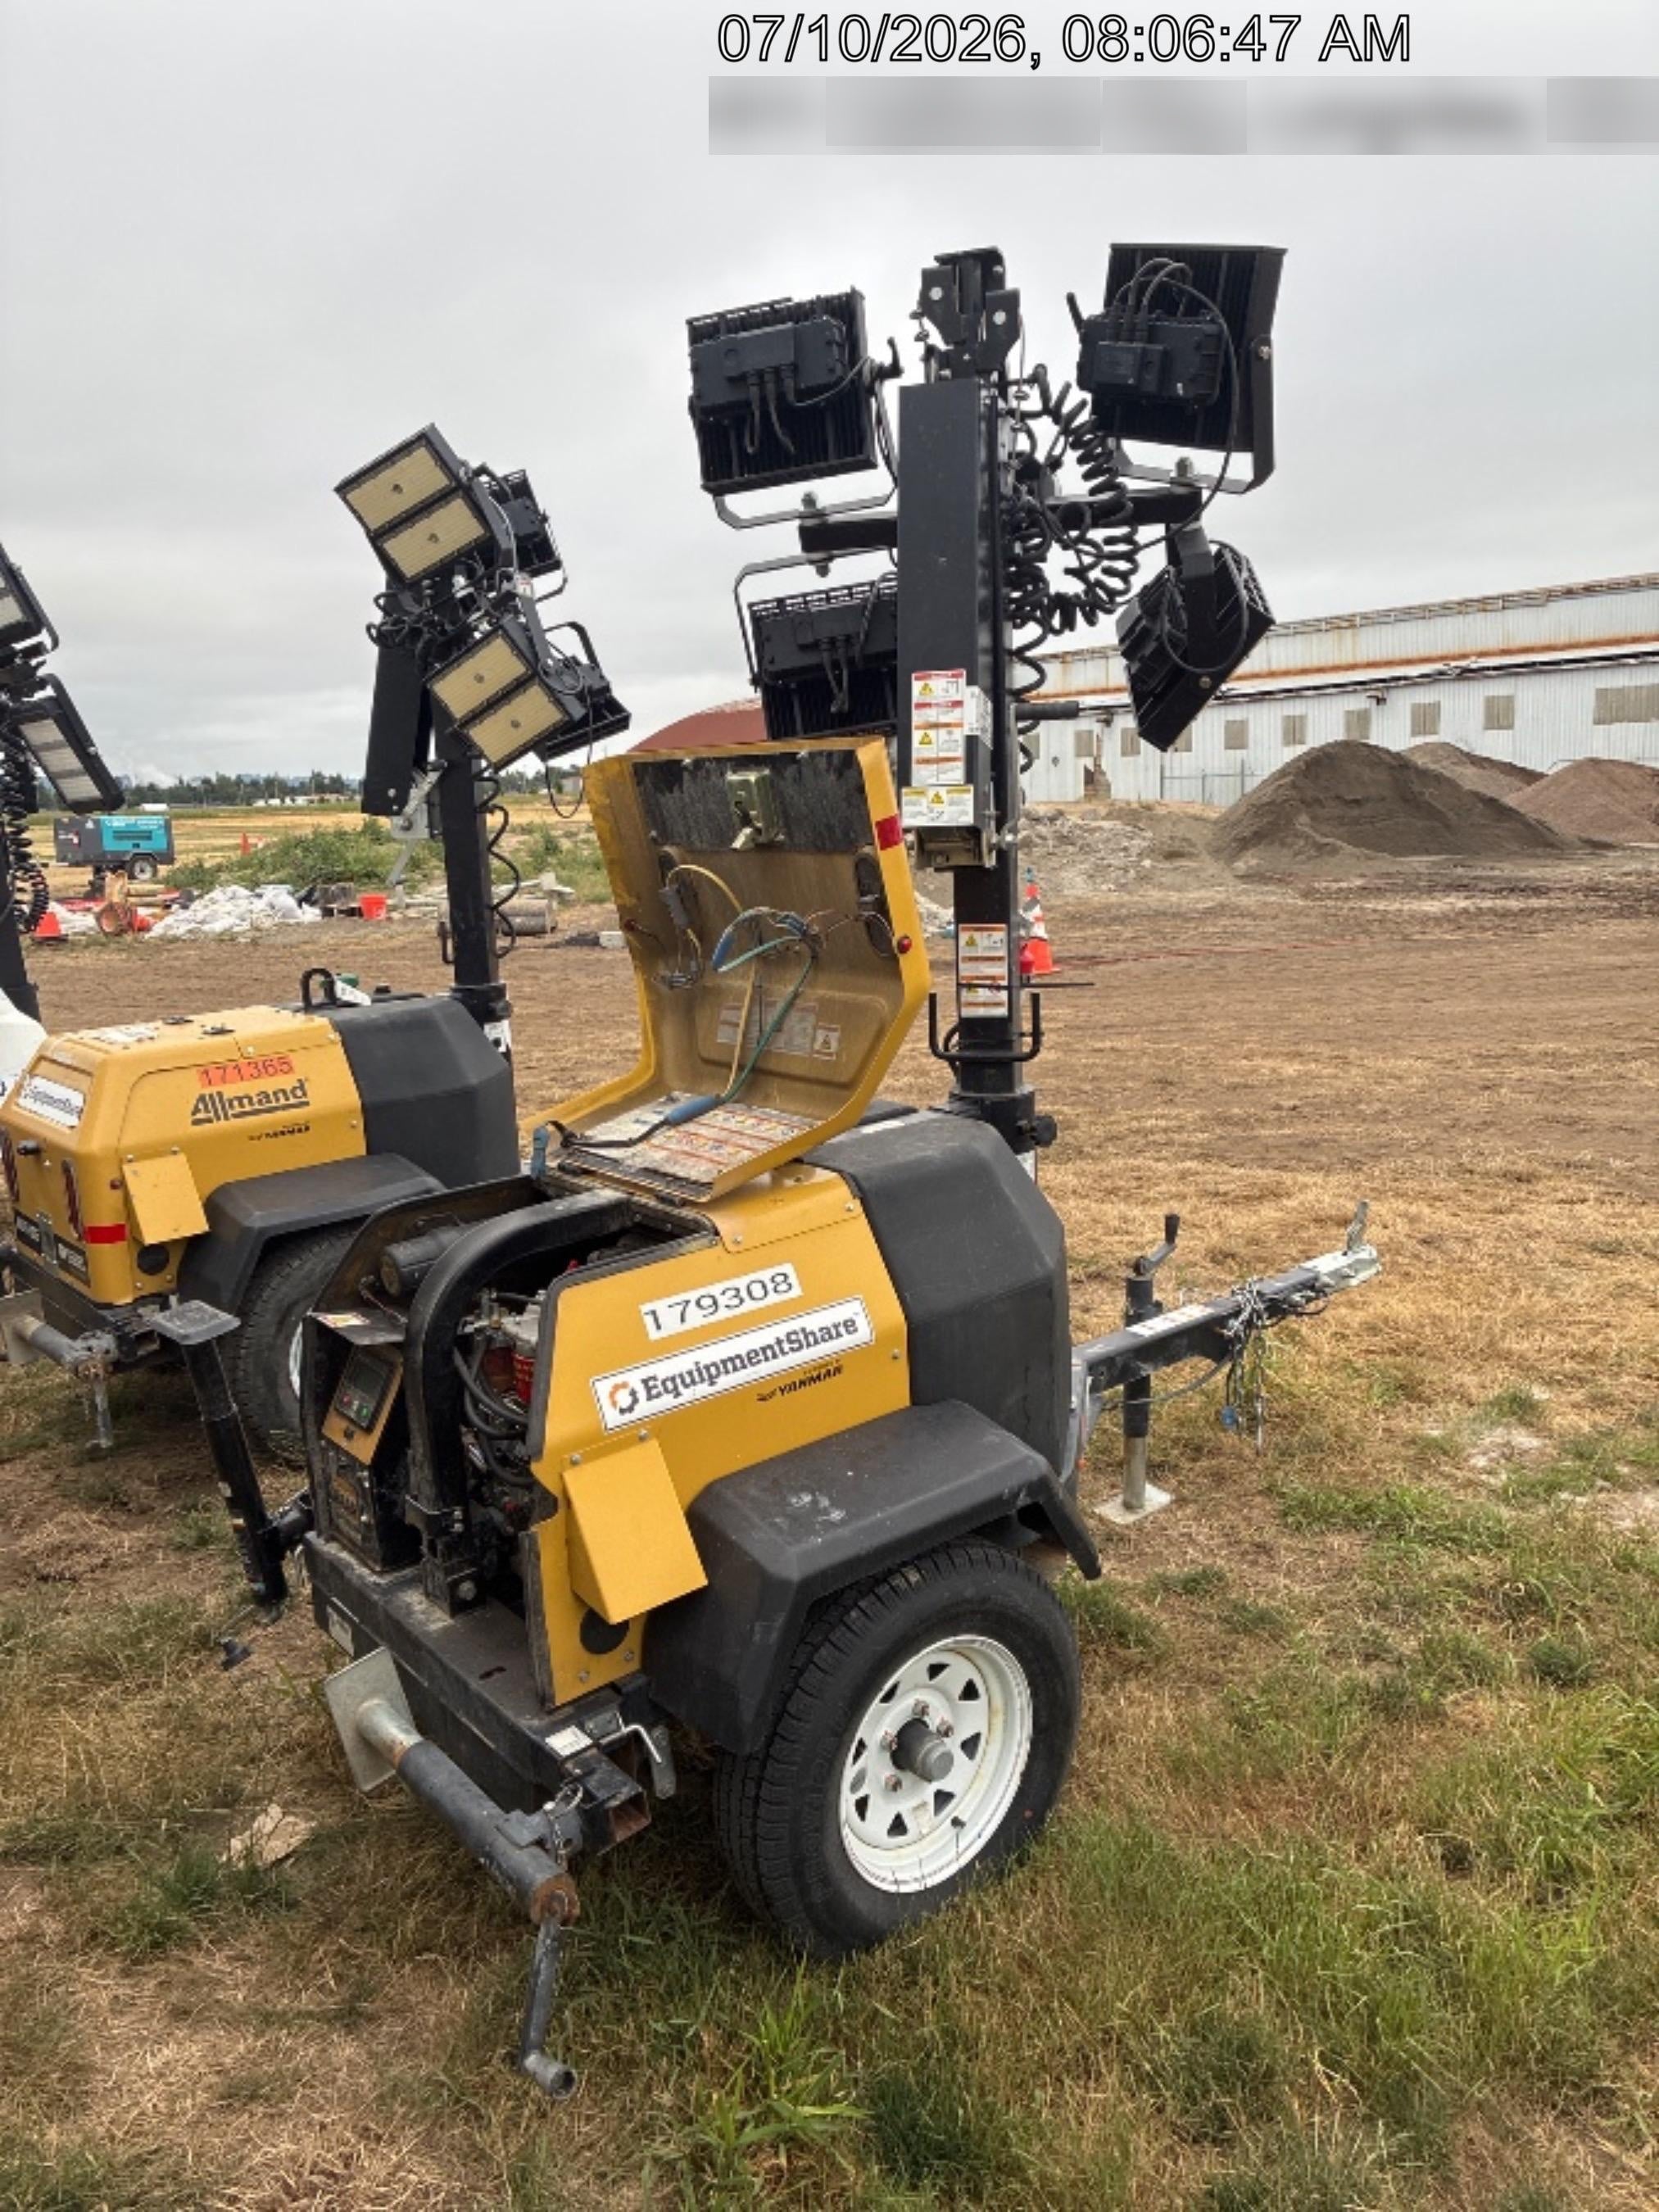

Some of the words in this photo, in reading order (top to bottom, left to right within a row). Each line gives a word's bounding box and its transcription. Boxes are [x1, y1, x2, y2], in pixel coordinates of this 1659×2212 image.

[201, 1056, 293, 1086] 171365
[191, 1078, 309, 1122] Allmand
[643, 1271, 793, 1331] 179308
[640, 1317, 859, 1402] EquipmentShare
